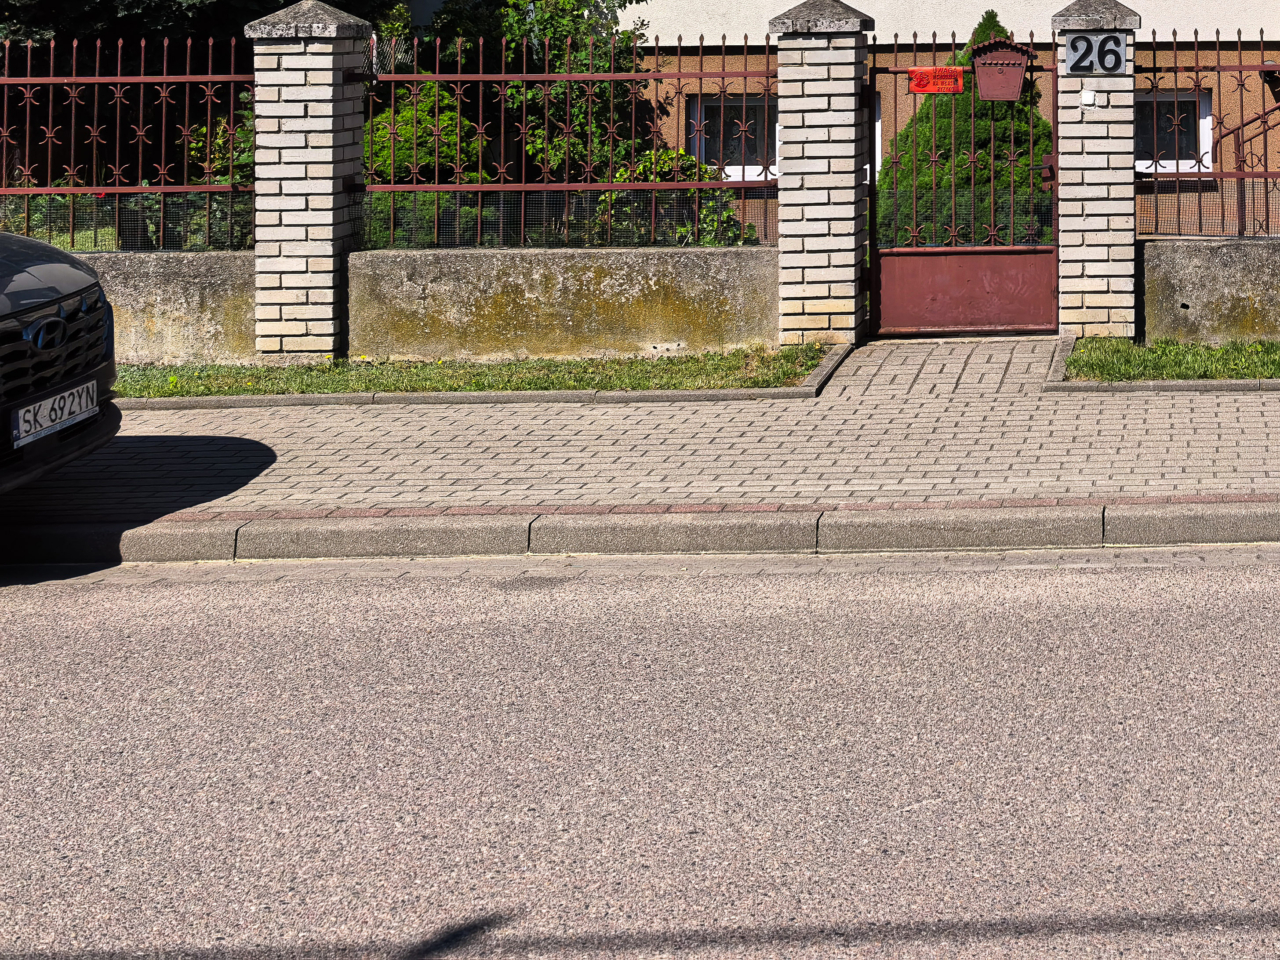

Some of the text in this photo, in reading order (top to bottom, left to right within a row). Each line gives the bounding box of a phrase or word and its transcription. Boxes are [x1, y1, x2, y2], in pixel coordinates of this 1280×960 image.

[1069, 35, 1122, 73] 26
[22, 382, 95, 434] SK 692YN
